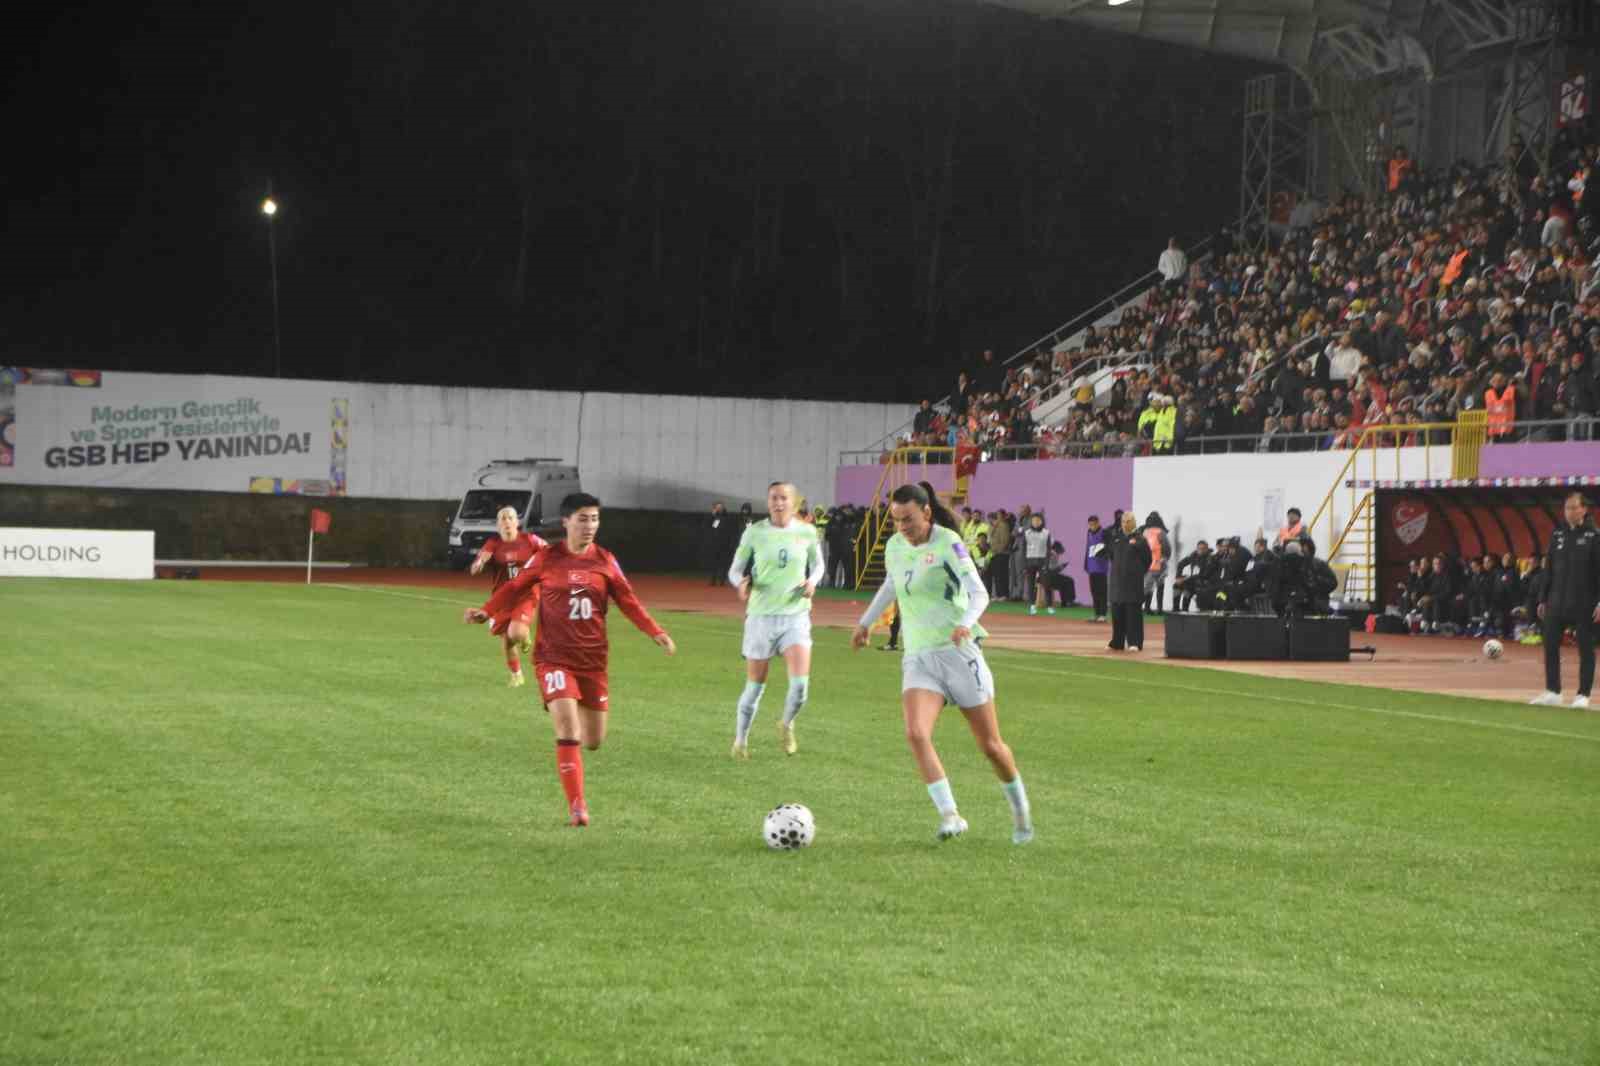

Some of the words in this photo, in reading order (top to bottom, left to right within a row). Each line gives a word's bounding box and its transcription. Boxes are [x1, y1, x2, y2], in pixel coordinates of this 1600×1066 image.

[91, 405, 177, 424] Modern
[70, 428, 96, 443] ve
[101, 424, 156, 444] Spor
[45, 446, 106, 469] GSB
[112, 440, 171, 464] HEP
[177, 432, 311, 460] YANINDA!
[778, 549, 787, 569] 9
[904, 570, 913, 596] 7
[568, 598, 592, 620] 20
[545, 671, 566, 693] 20
[967, 659, 981, 690] 7
